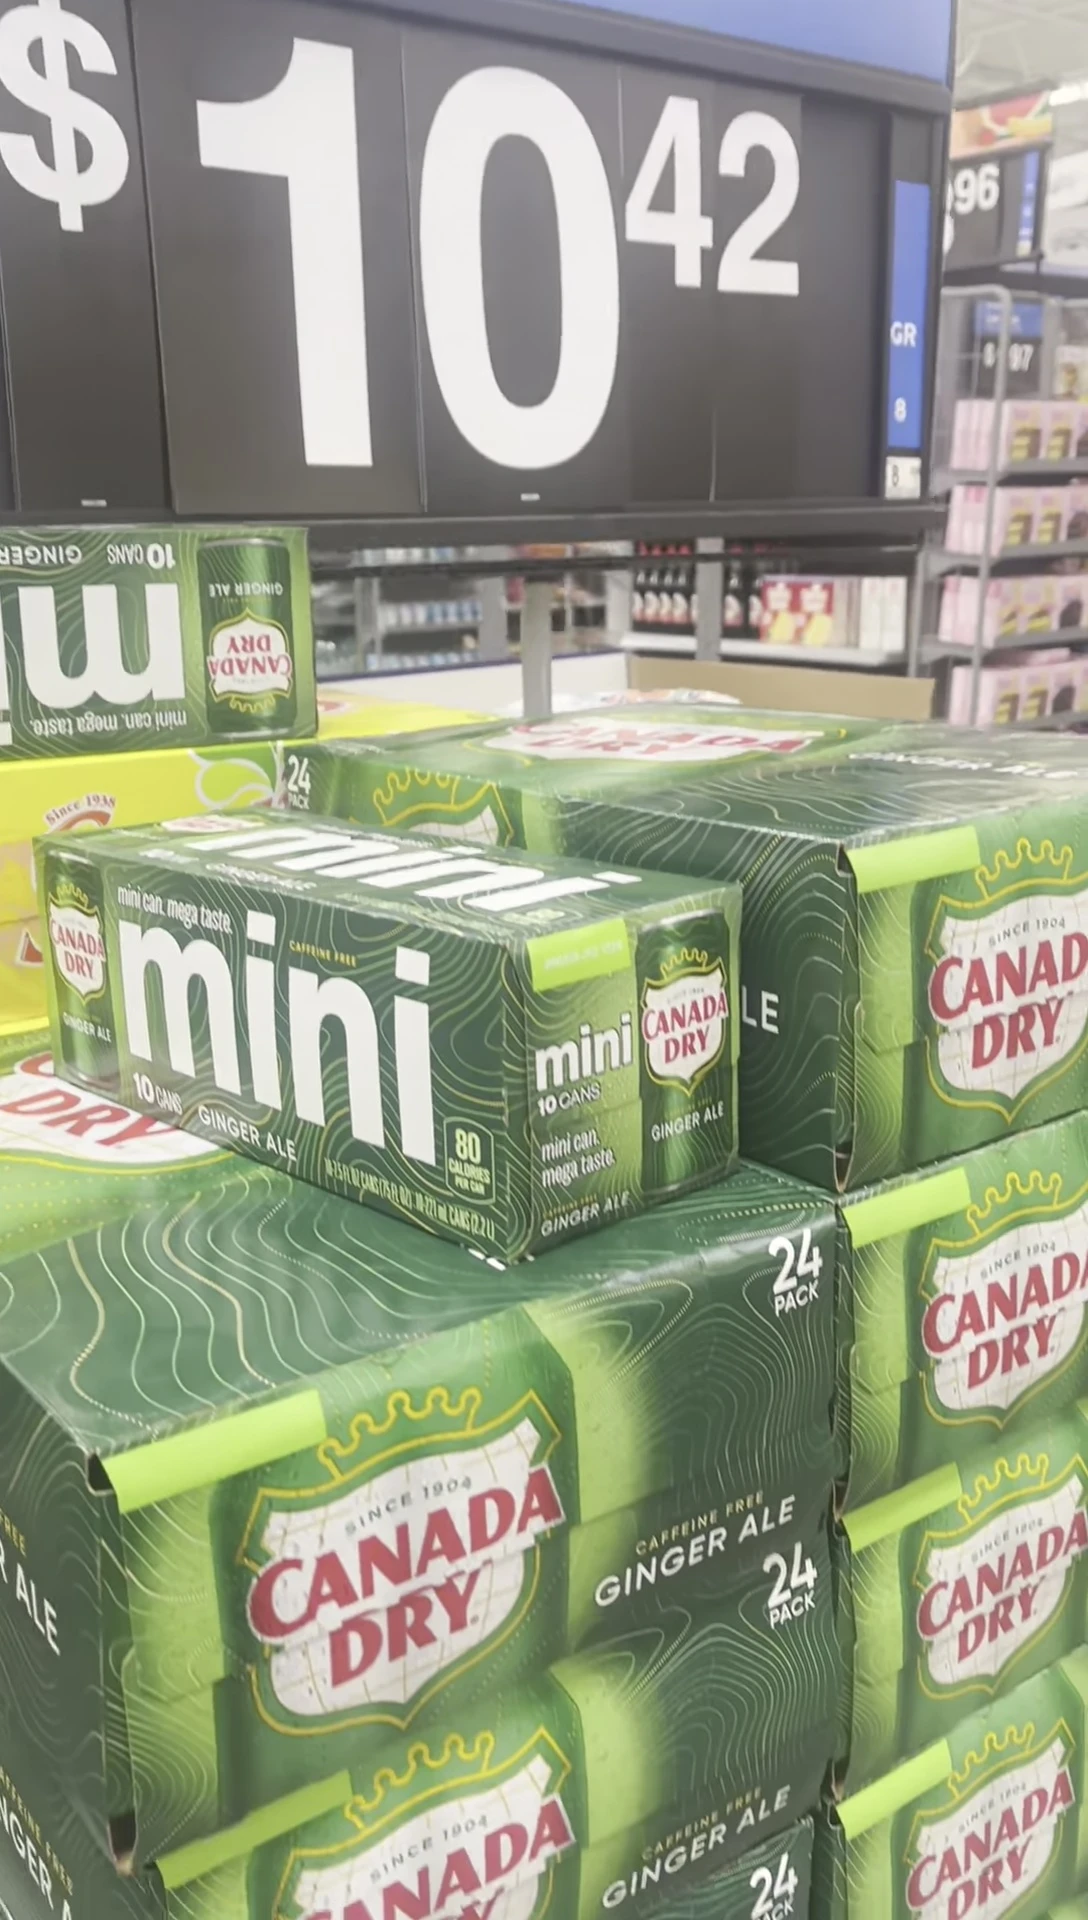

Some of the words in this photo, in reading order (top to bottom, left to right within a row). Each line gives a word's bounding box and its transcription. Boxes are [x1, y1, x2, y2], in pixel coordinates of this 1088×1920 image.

[0, 0, 129, 232] $
[625, 95, 800, 296] 42
[890, 321, 918, 348] GR
[894, 397, 907, 424] 8
[107, 543, 144, 565] CANS
[147, 543, 176, 570] 10
[227, 634, 272, 654] DRY
[208, 654, 292, 676] CANADA
[287, 754, 311, 794] 24
[118, 883, 143, 908] mini
[167, 898, 199, 929] mega
[51, 919, 105, 959] CANADA
[289, 939, 331, 962] CAFFEINE
[988, 919, 1030, 947] SINCE
[64, 950, 94, 980] DRY
[642, 991, 728, 1042] CANADA
[118, 909, 437, 1167] mini
[535, 1012, 634, 1092] mini
[664, 1023, 711, 1064] DRY
[133, 1071, 155, 1104] 10
[155, 1085, 185, 1116] CANS
[537, 1093, 558, 1118] 10
[558, 1082, 601, 1111] CANS
[0, 1088, 181, 1147] DRY
[198, 1105, 262, 1147] GINGER
[265, 1133, 297, 1162] ALE
[651, 1110, 701, 1142] GINGER
[703, 1100, 724, 1123] ALE
[455, 1127, 481, 1165] 80
[541, 1131, 571, 1163] mini
[448, 1157, 491, 1185] CALORIES
[541, 1160, 579, 1188] mega
[541, 1202, 600, 1238] GINGER
[768, 1228, 822, 1295] 24
[980, 1249, 1021, 1279] SINCE
[774, 1278, 819, 1317] PACK
[344, 1493, 415, 1536] SINCE
[422, 1476, 473, 1500] 1904
[635, 1508, 718, 1556] CAFFEINE
[726, 1490, 764, 1518] FREE
[250, 1467, 563, 1639] CANADA
[594, 1526, 728, 1608] GINGER
[738, 1494, 796, 1544] ALE
[971, 1530, 1011, 1563] SINCE
[762, 1541, 818, 1609] 24
[918, 1511, 1088, 1637] CANADA
[16, 1562, 61, 1657] ALE
[769, 1593, 816, 1630] PACK
[641, 1809, 719, 1861] CAFFEINE
[726, 1786, 762, 1815] FREE
[958, 1797, 996, 1834] SINCE
[370, 1836, 434, 1883] SINCE
[442, 1814, 489, 1842] 1904
[602, 1823, 727, 1909] GINGER
[736, 1784, 791, 1834] ALE
[907, 1769, 1074, 1908] CANADA
[750, 1851, 798, 1920] 24
